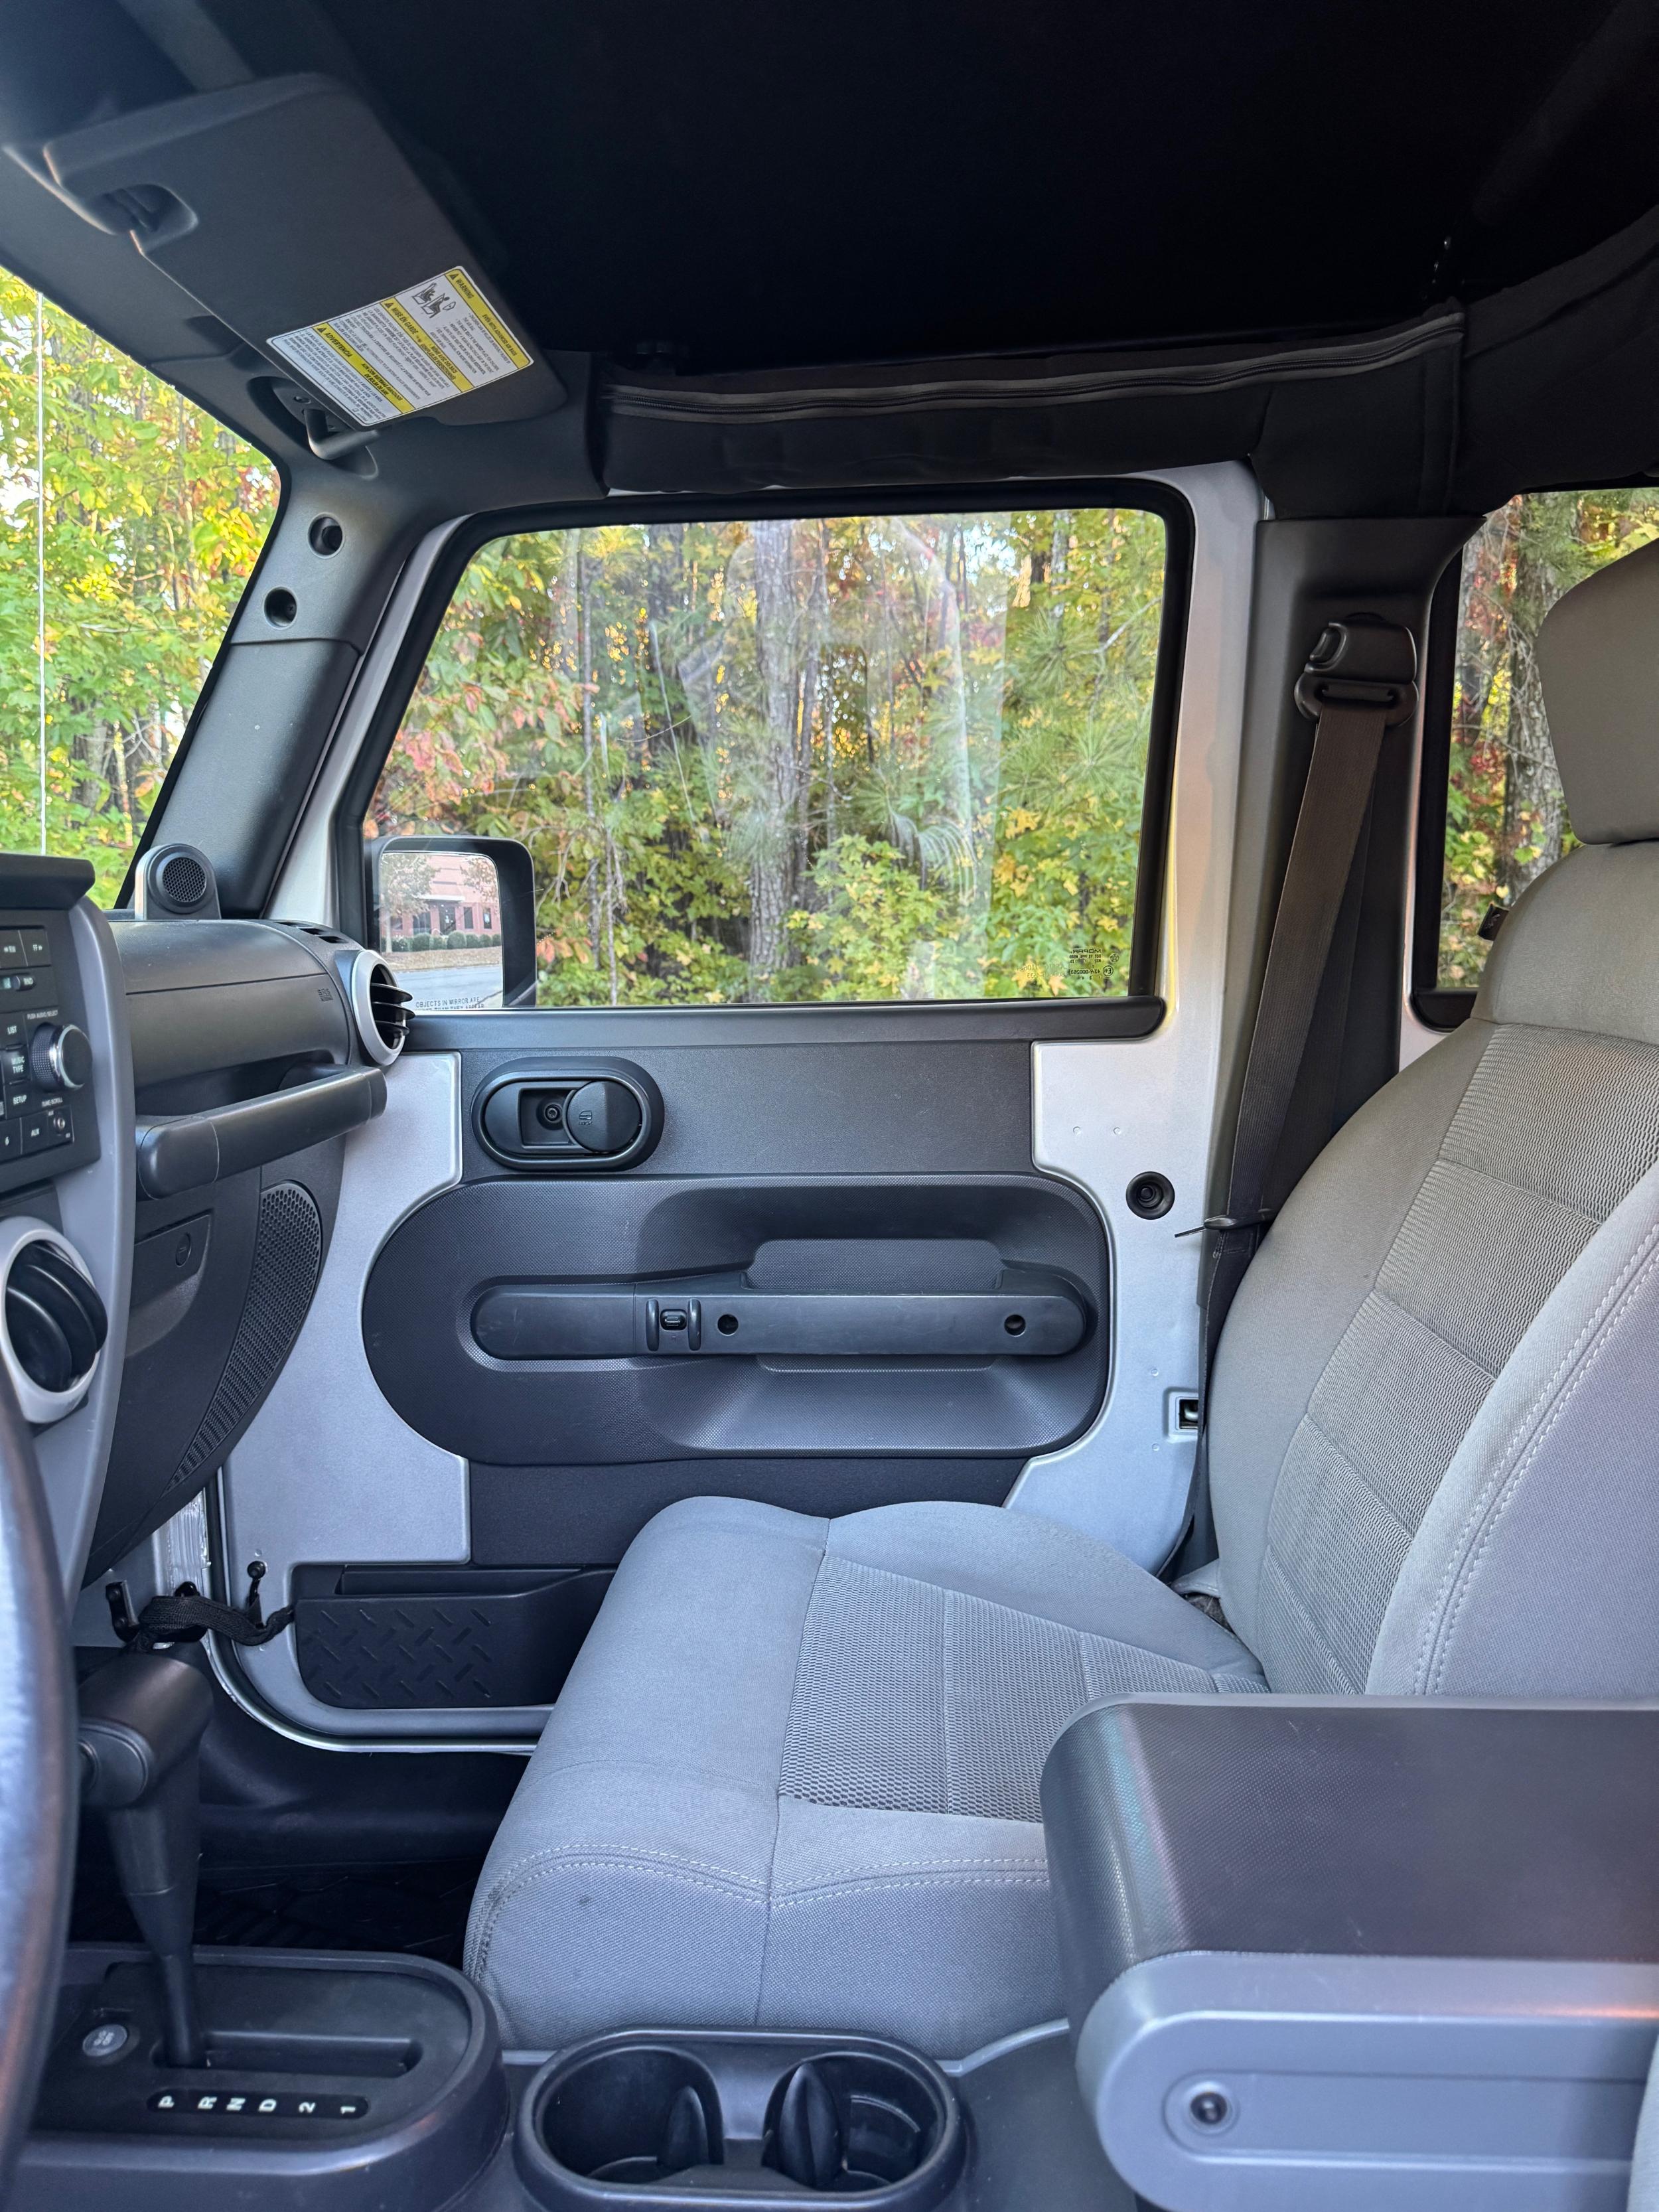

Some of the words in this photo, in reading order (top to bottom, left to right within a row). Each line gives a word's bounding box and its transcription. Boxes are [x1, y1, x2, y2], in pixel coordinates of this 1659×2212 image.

[454, 278, 474, 299] WARNING
[390, 307, 403, 318] MISE
[403, 321, 419, 334] GARDE
[323, 331, 354, 358] ADVERTENCIA
[7, 1025, 17, 1035] LIST
[13, 1065, 24, 1074] TYPE
[13, 1095, 27, 1104] SETUP
[31, 1128, 40, 1137] AUX
[5, 1136, 9, 1145] 6
[158, 2096, 175, 2108] P
[198, 2097, 217, 2109] R
[226, 2097, 246, 2111] N
[258, 2099, 277, 2112] D
[299, 2102, 316, 2113] 2
